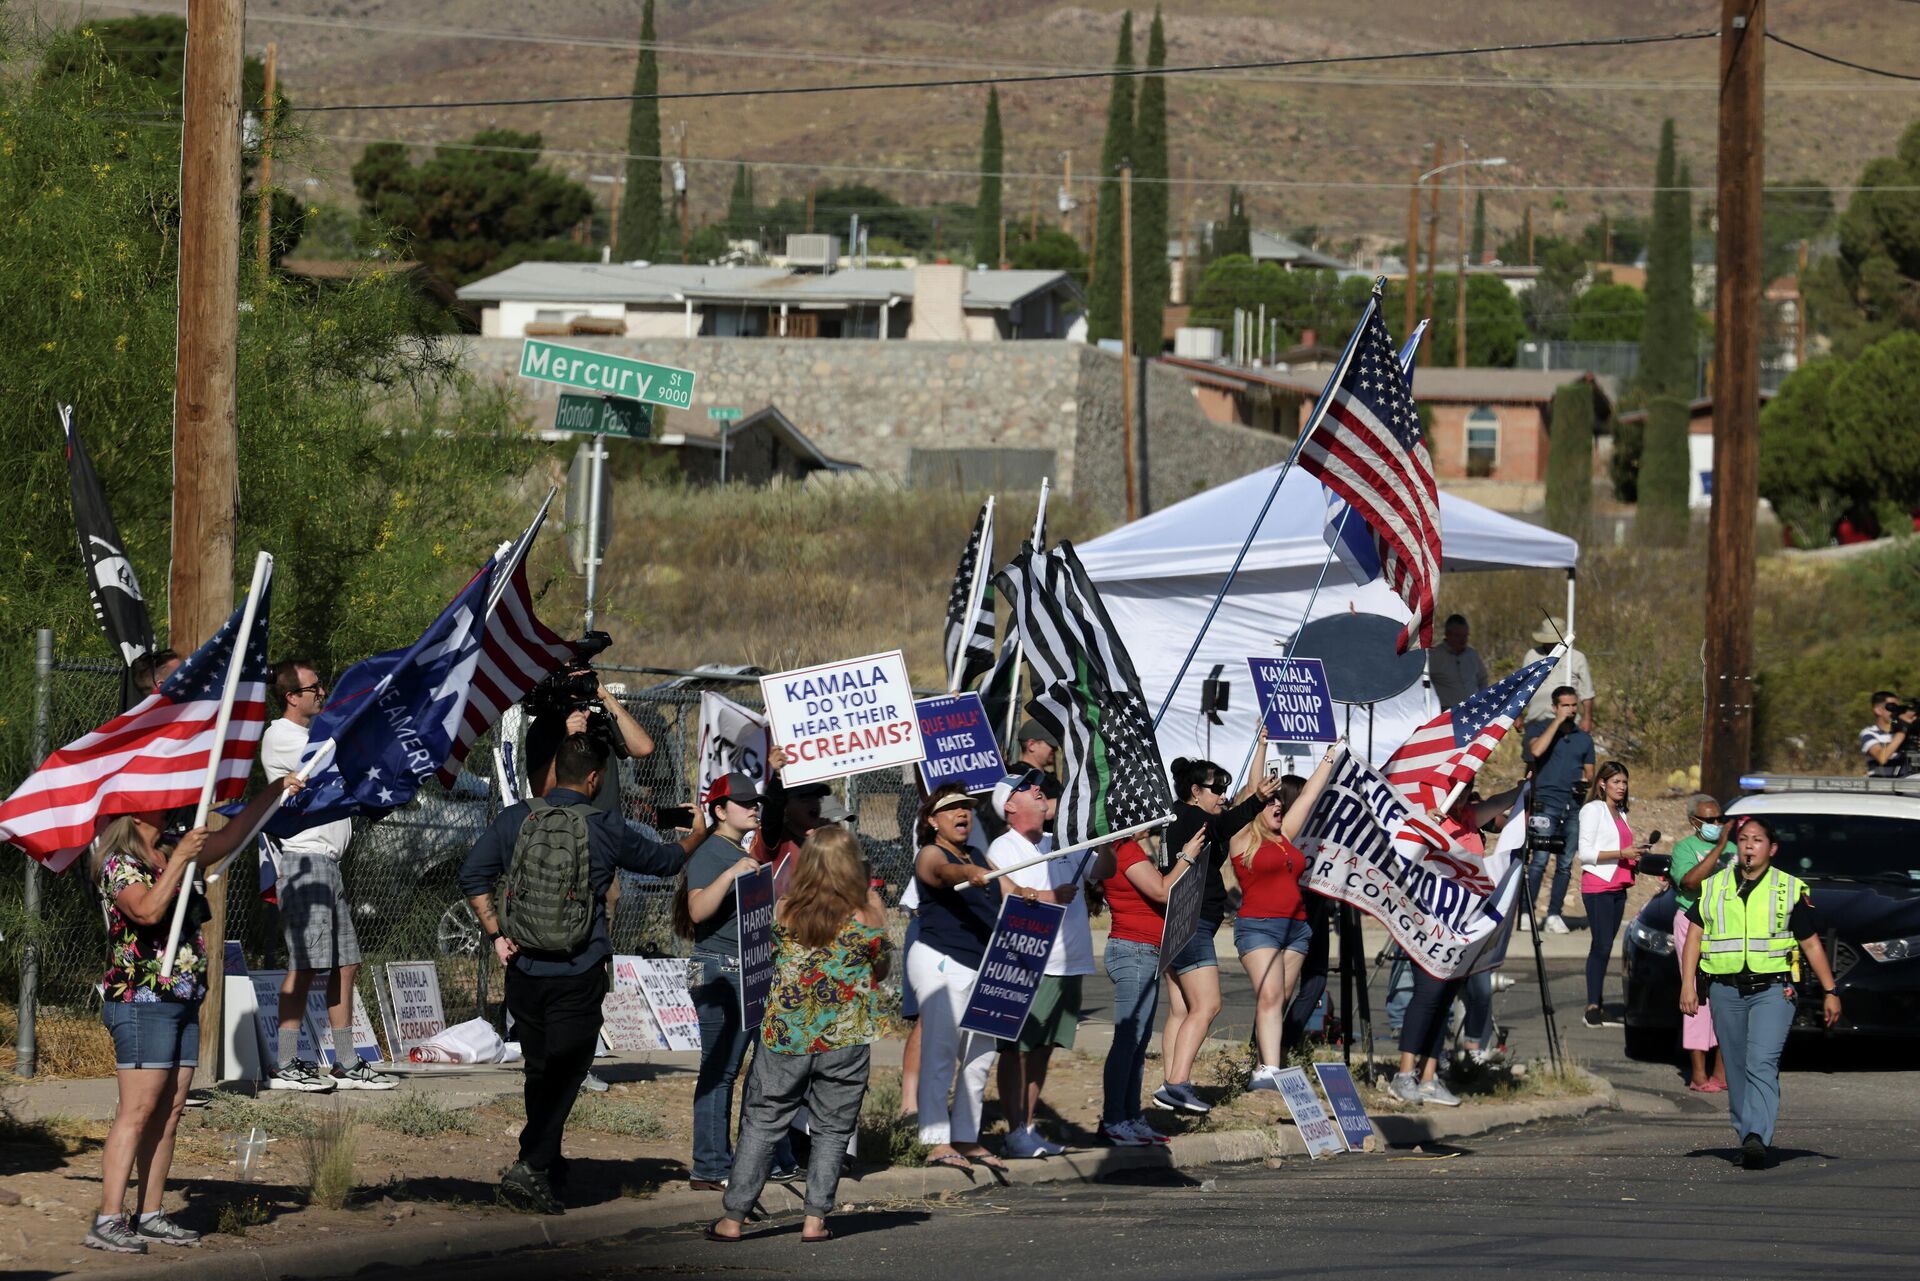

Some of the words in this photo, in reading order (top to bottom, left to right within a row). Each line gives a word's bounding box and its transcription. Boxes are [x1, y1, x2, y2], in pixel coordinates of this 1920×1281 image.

[525, 344, 653, 399] Mercury
[669, 373, 682, 387] St
[658, 387, 688, 404] 9000
[557, 398, 594, 428] Hondo
[600, 403, 632, 432] Pass
[785, 666, 888, 702] KAMALA
[1260, 666, 1317, 686] KAMALA,
[1272, 683, 1288, 693] YOU
[1290, 685, 1311, 693] KNOW
[806, 698, 833, 716] DO
[837, 689, 877, 709] YOU
[1266, 693, 1322, 713] TRUMP
[793, 716, 841, 738] HEAR
[844, 705, 898, 727] THEIR
[1279, 714, 1320, 733] WON
[384, 702, 437, 785] AMERIC
[784, 721, 913, 765] SCREAMS?
[936, 733, 976, 752] HATES
[926, 750, 998, 778] MEXICANS
[1330, 849, 1445, 939] JACKSON
[1776, 882, 1787, 929] POLICE
[743, 904, 772, 934] HARRIS
[1304, 855, 1333, 878] OR
[1346, 872, 1467, 966] CONGRESS
[996, 931, 1049, 958] HARRIS
[394, 971, 428, 988] KAMALA
[984, 961, 1039, 988] HUMAN
[404, 990, 413, 1003] DO
[413, 989, 427, 1002] YOU
[980, 983, 1029, 1004] TRAFFICKING
[401, 1007, 416, 1019] HEAR
[417, 1006, 435, 1018] THEIR
